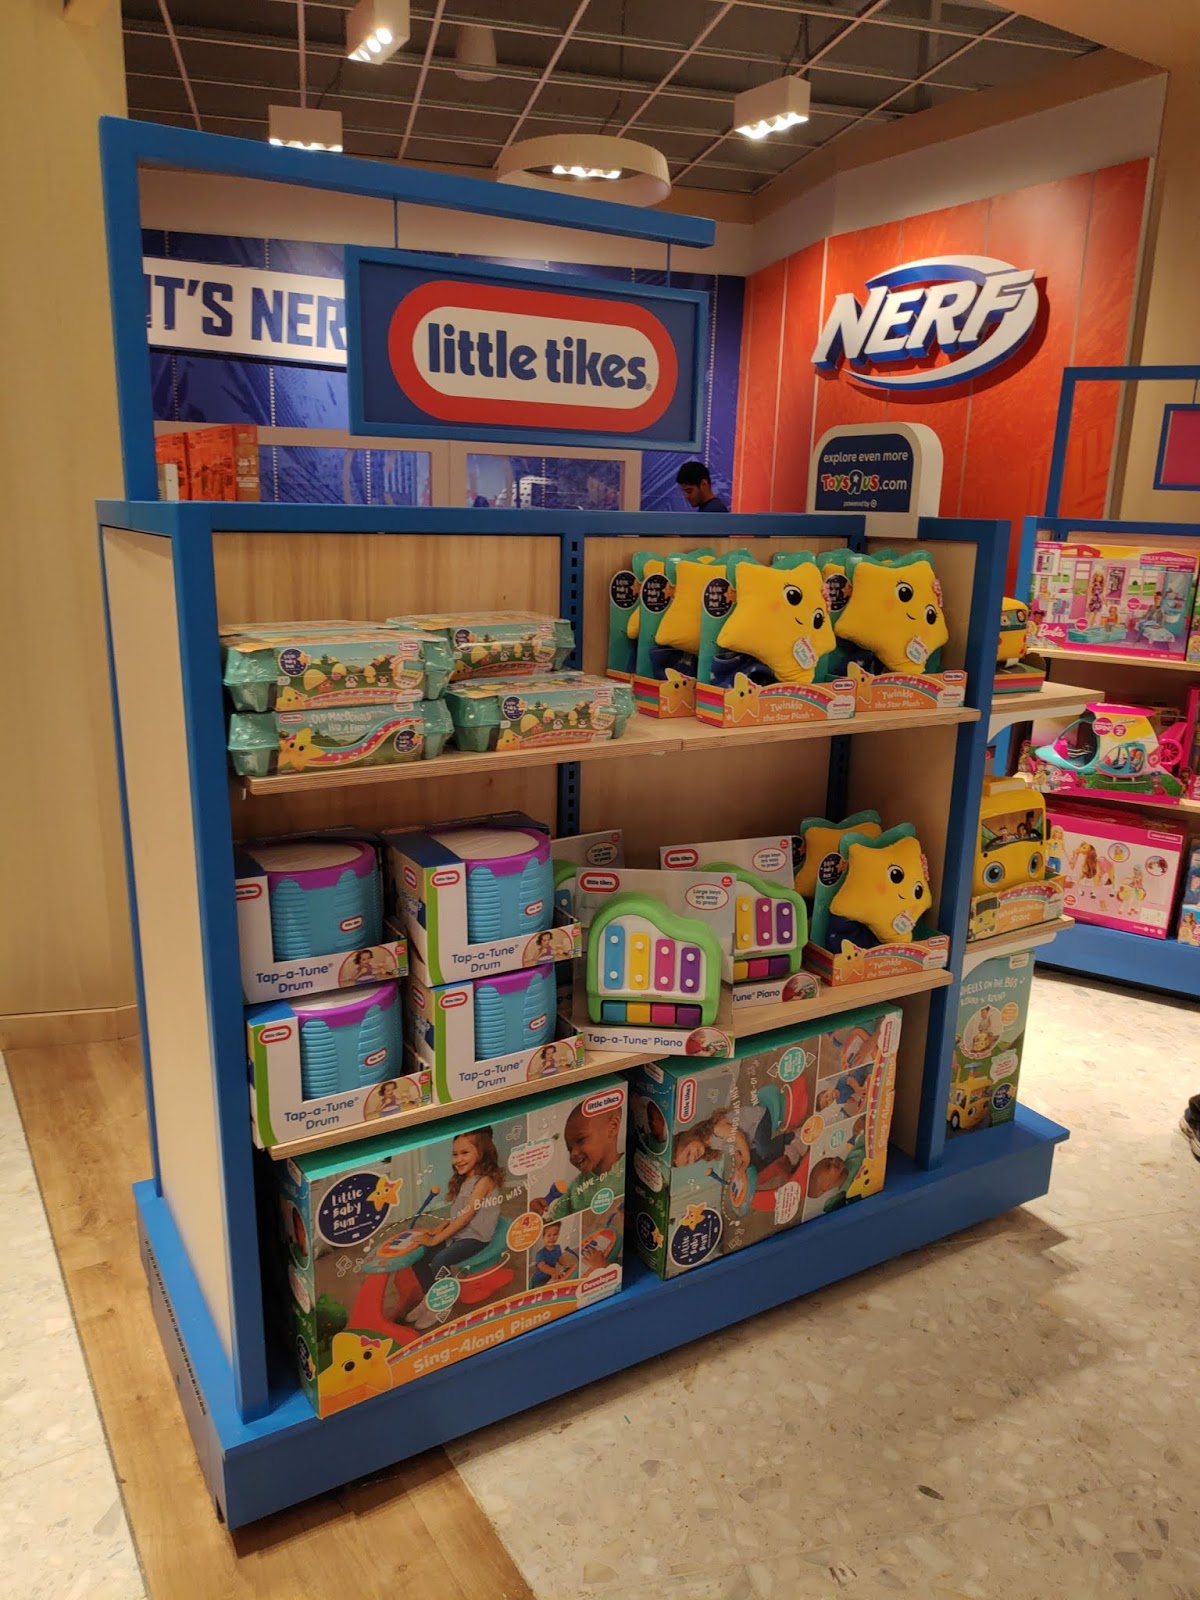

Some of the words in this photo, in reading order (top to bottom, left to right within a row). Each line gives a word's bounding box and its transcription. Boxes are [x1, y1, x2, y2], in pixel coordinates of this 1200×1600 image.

[811, 268, 1035, 370] NERF
[428, 322, 537, 381] little
[546, 336, 648, 391] tikes
[823, 452, 857, 466] explore
[858, 452, 881, 462] even
[882, 451, 909, 461] more
[770, 701, 803, 712] Twinkle
[451, 947, 514, 965] Tap-a-Tune
[256, 965, 329, 984] Tap-a-Tune
[470, 961, 501, 973] Drum
[278, 980, 313, 993] Drum
[757, 990, 780, 999] Piano
[588, 1034, 648, 1045] Tap-a-Tune
[654, 1037, 683, 1046] Piano
[459, 1061, 520, 1082] Tap-a-Tune
[477, 1077, 506, 1090] Drum
[284, 1098, 354, 1122] Tap-a-Tune
[587, 1101, 603, 1110] little
[603, 1096, 620, 1106] tikes
[305, 1116, 340, 1130] Drum
[331, 1188, 363, 1206] Little
[332, 1201, 361, 1218] Baby
[333, 1215, 356, 1230] Bum
[412, 1327, 505, 1374] Sing-Along
[510, 1309, 551, 1333] Piano
